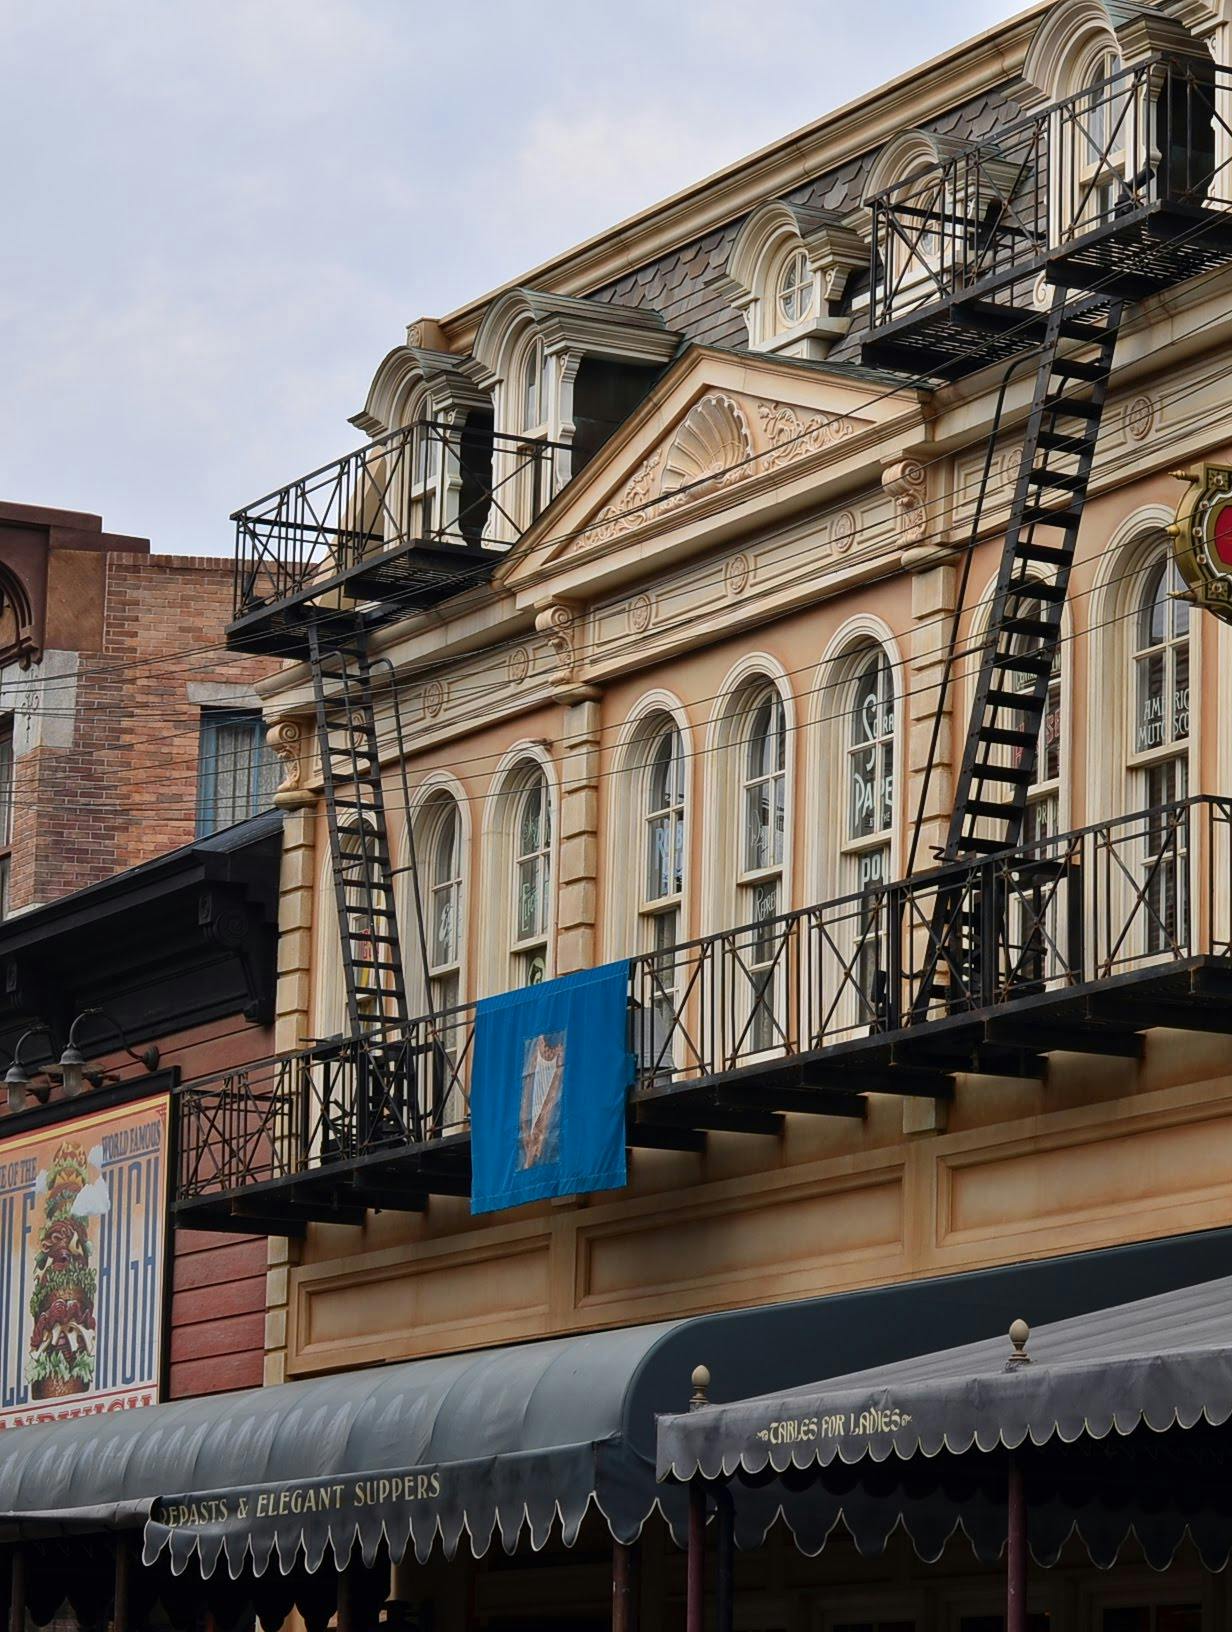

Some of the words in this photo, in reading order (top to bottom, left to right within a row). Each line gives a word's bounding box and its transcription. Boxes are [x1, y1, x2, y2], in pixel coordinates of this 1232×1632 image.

[768, 1417, 818, 1445] TABLES
[821, 1414, 845, 1438] FOR
[850, 1407, 901, 1436] LADIES
[237, 1497, 249, 1519] &
[256, 1485, 345, 1518] ELEGANT
[354, 1472, 440, 1506] SUPPERS
